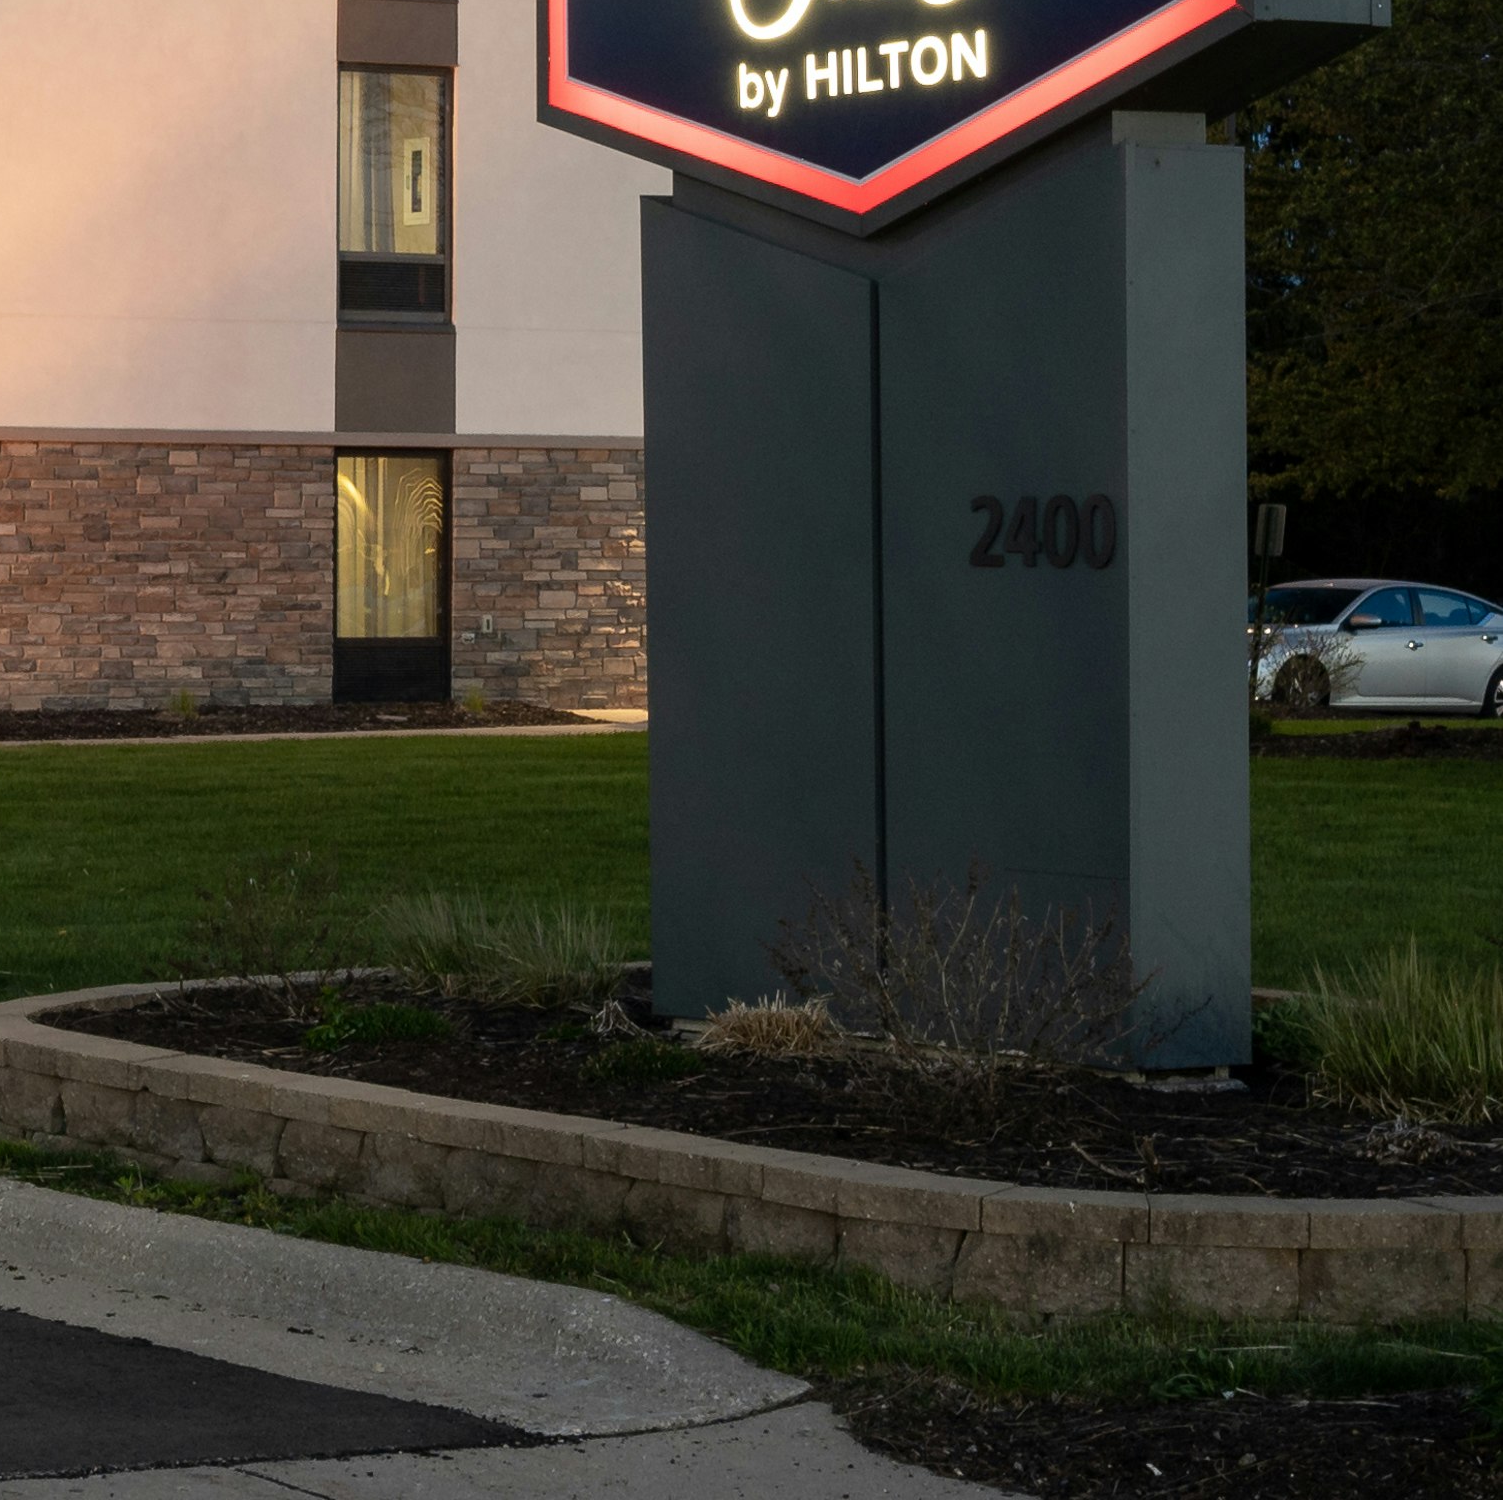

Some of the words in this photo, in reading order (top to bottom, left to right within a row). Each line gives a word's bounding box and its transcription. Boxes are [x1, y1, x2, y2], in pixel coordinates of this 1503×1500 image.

[738, 62, 789, 118] by
[805, 30, 988, 100] HILTON
[969, 494, 1116, 569] 2400
